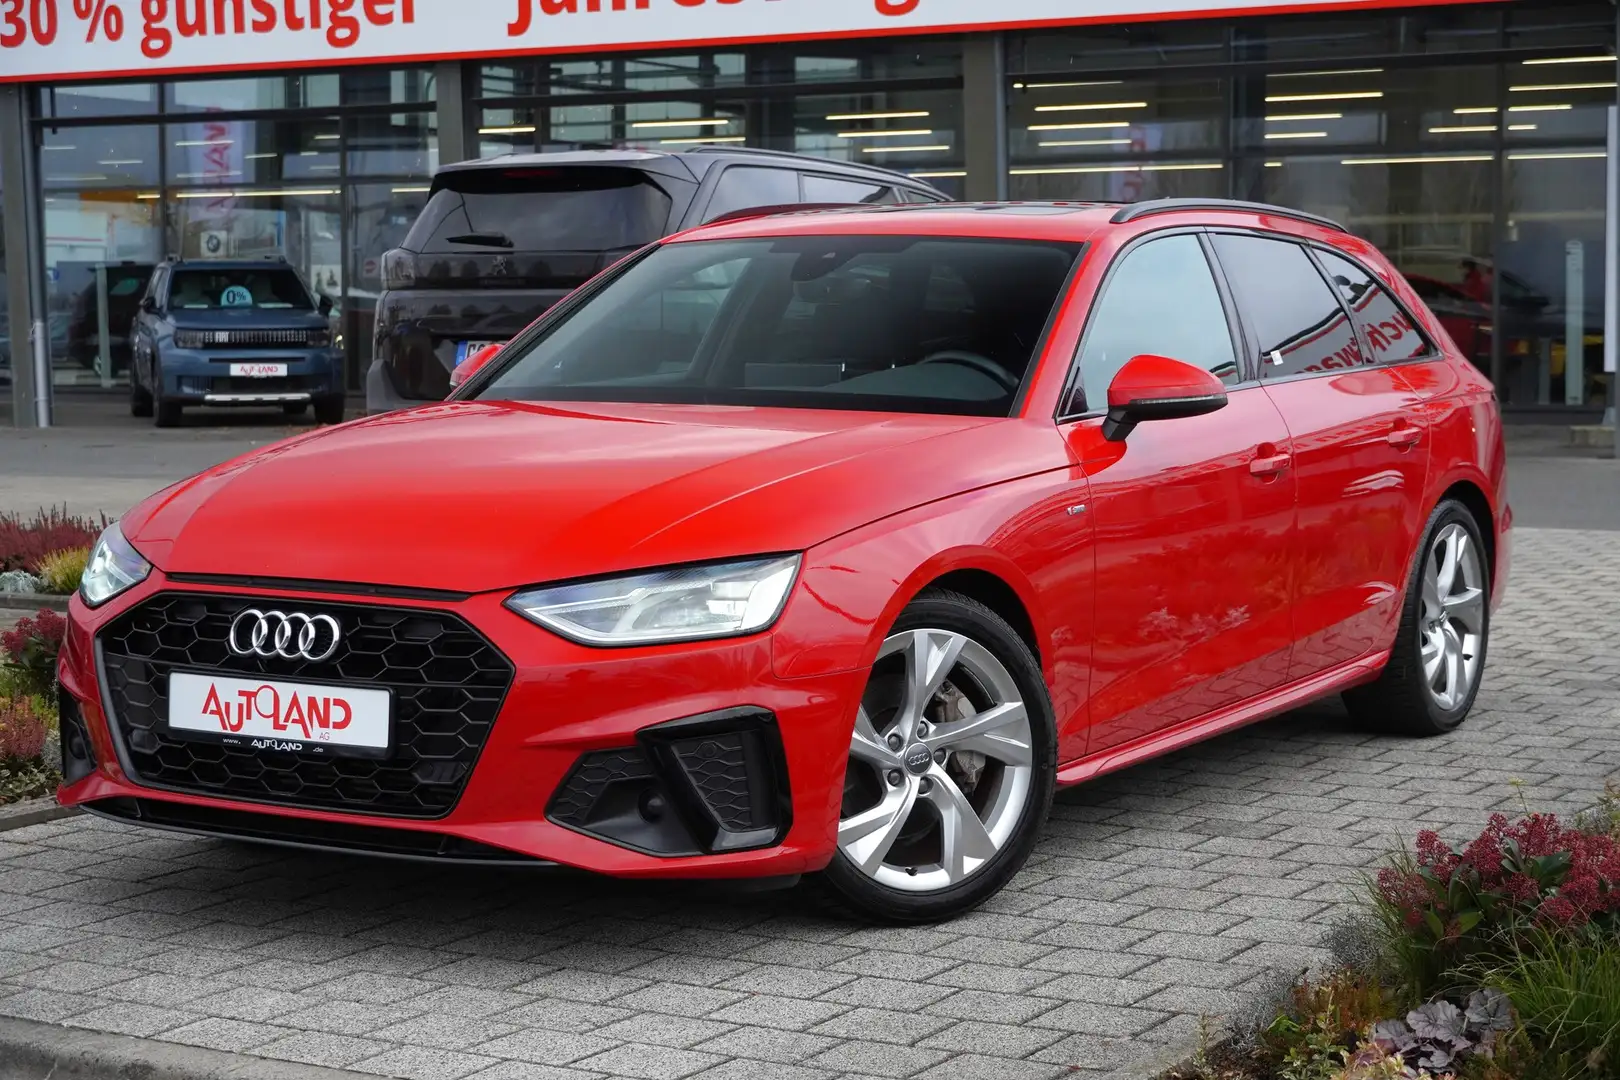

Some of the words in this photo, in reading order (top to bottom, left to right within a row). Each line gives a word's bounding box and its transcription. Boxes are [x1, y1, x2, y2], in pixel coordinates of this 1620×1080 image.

[0, 0, 58, 48] 30
[73, 0, 124, 43] %
[226, 289, 247, 304] 0%
[215, 331, 229, 343] FIAT
[240, 365, 279, 375] AUTLAND
[201, 682, 353, 738] AUTOLAND
[319, 731, 330, 741] AG
[251, 739, 303, 752] AUTOLAND
